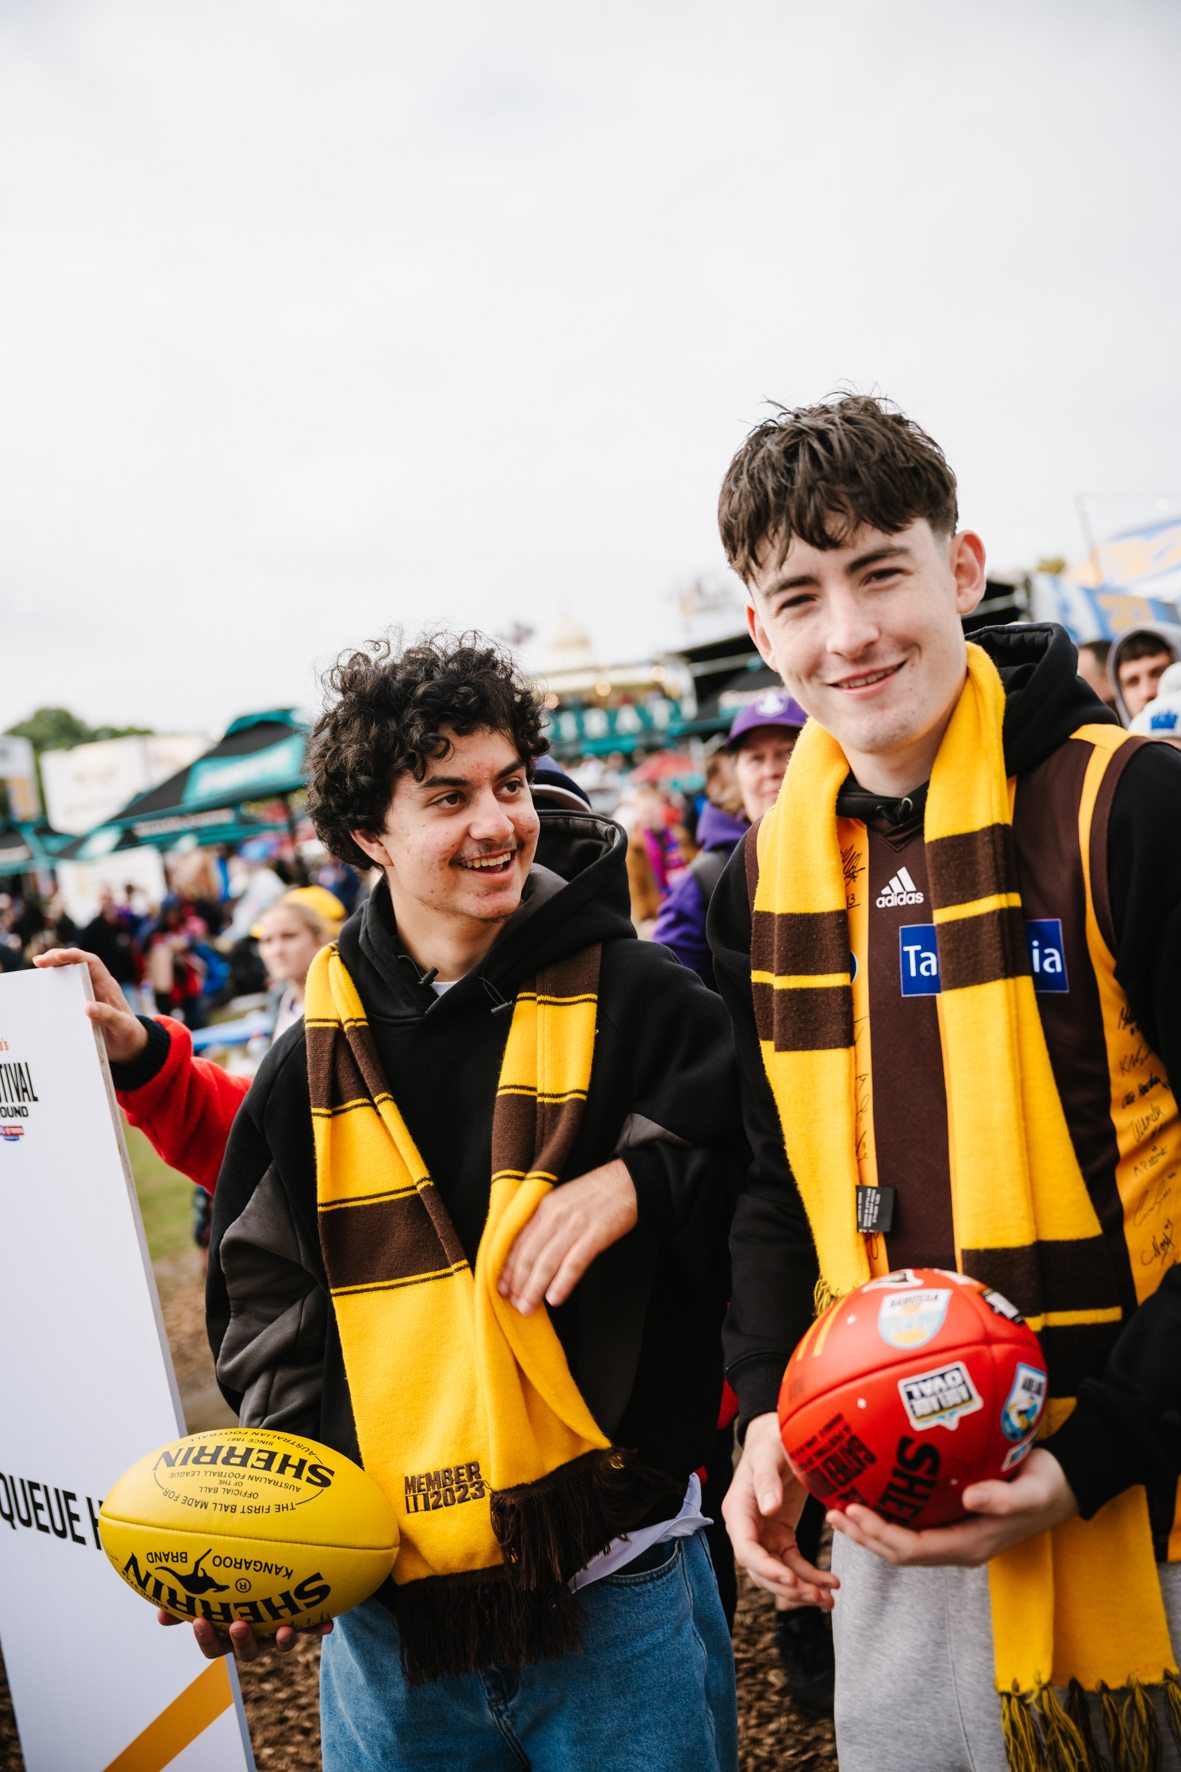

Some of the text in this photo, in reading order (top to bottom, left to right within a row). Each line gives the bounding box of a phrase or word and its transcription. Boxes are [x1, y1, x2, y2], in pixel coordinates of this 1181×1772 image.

[876, 891, 924, 908] adidas
[248, 1438, 274, 1446] SINCE
[252, 1431, 317, 1456] AUSTRALIAN
[152, 1446, 335, 1488] SHERRIN
[404, 1461, 482, 1495] MEMBER
[169, 1470, 302, 1493] AUSTRALIAN FOOTBALL LEAGUE
[199, 1486, 259, 1500] OFFICIAL BALL
[430, 1480, 485, 1510] 2023
[0, 1471, 87, 1546] QUEUE
[162, 1487, 296, 1514] THE FIRST BALL MADE FOR
[146, 1551, 293, 1579] KANGAROO BRAND
[123, 1552, 331, 1624] SHERRIN
